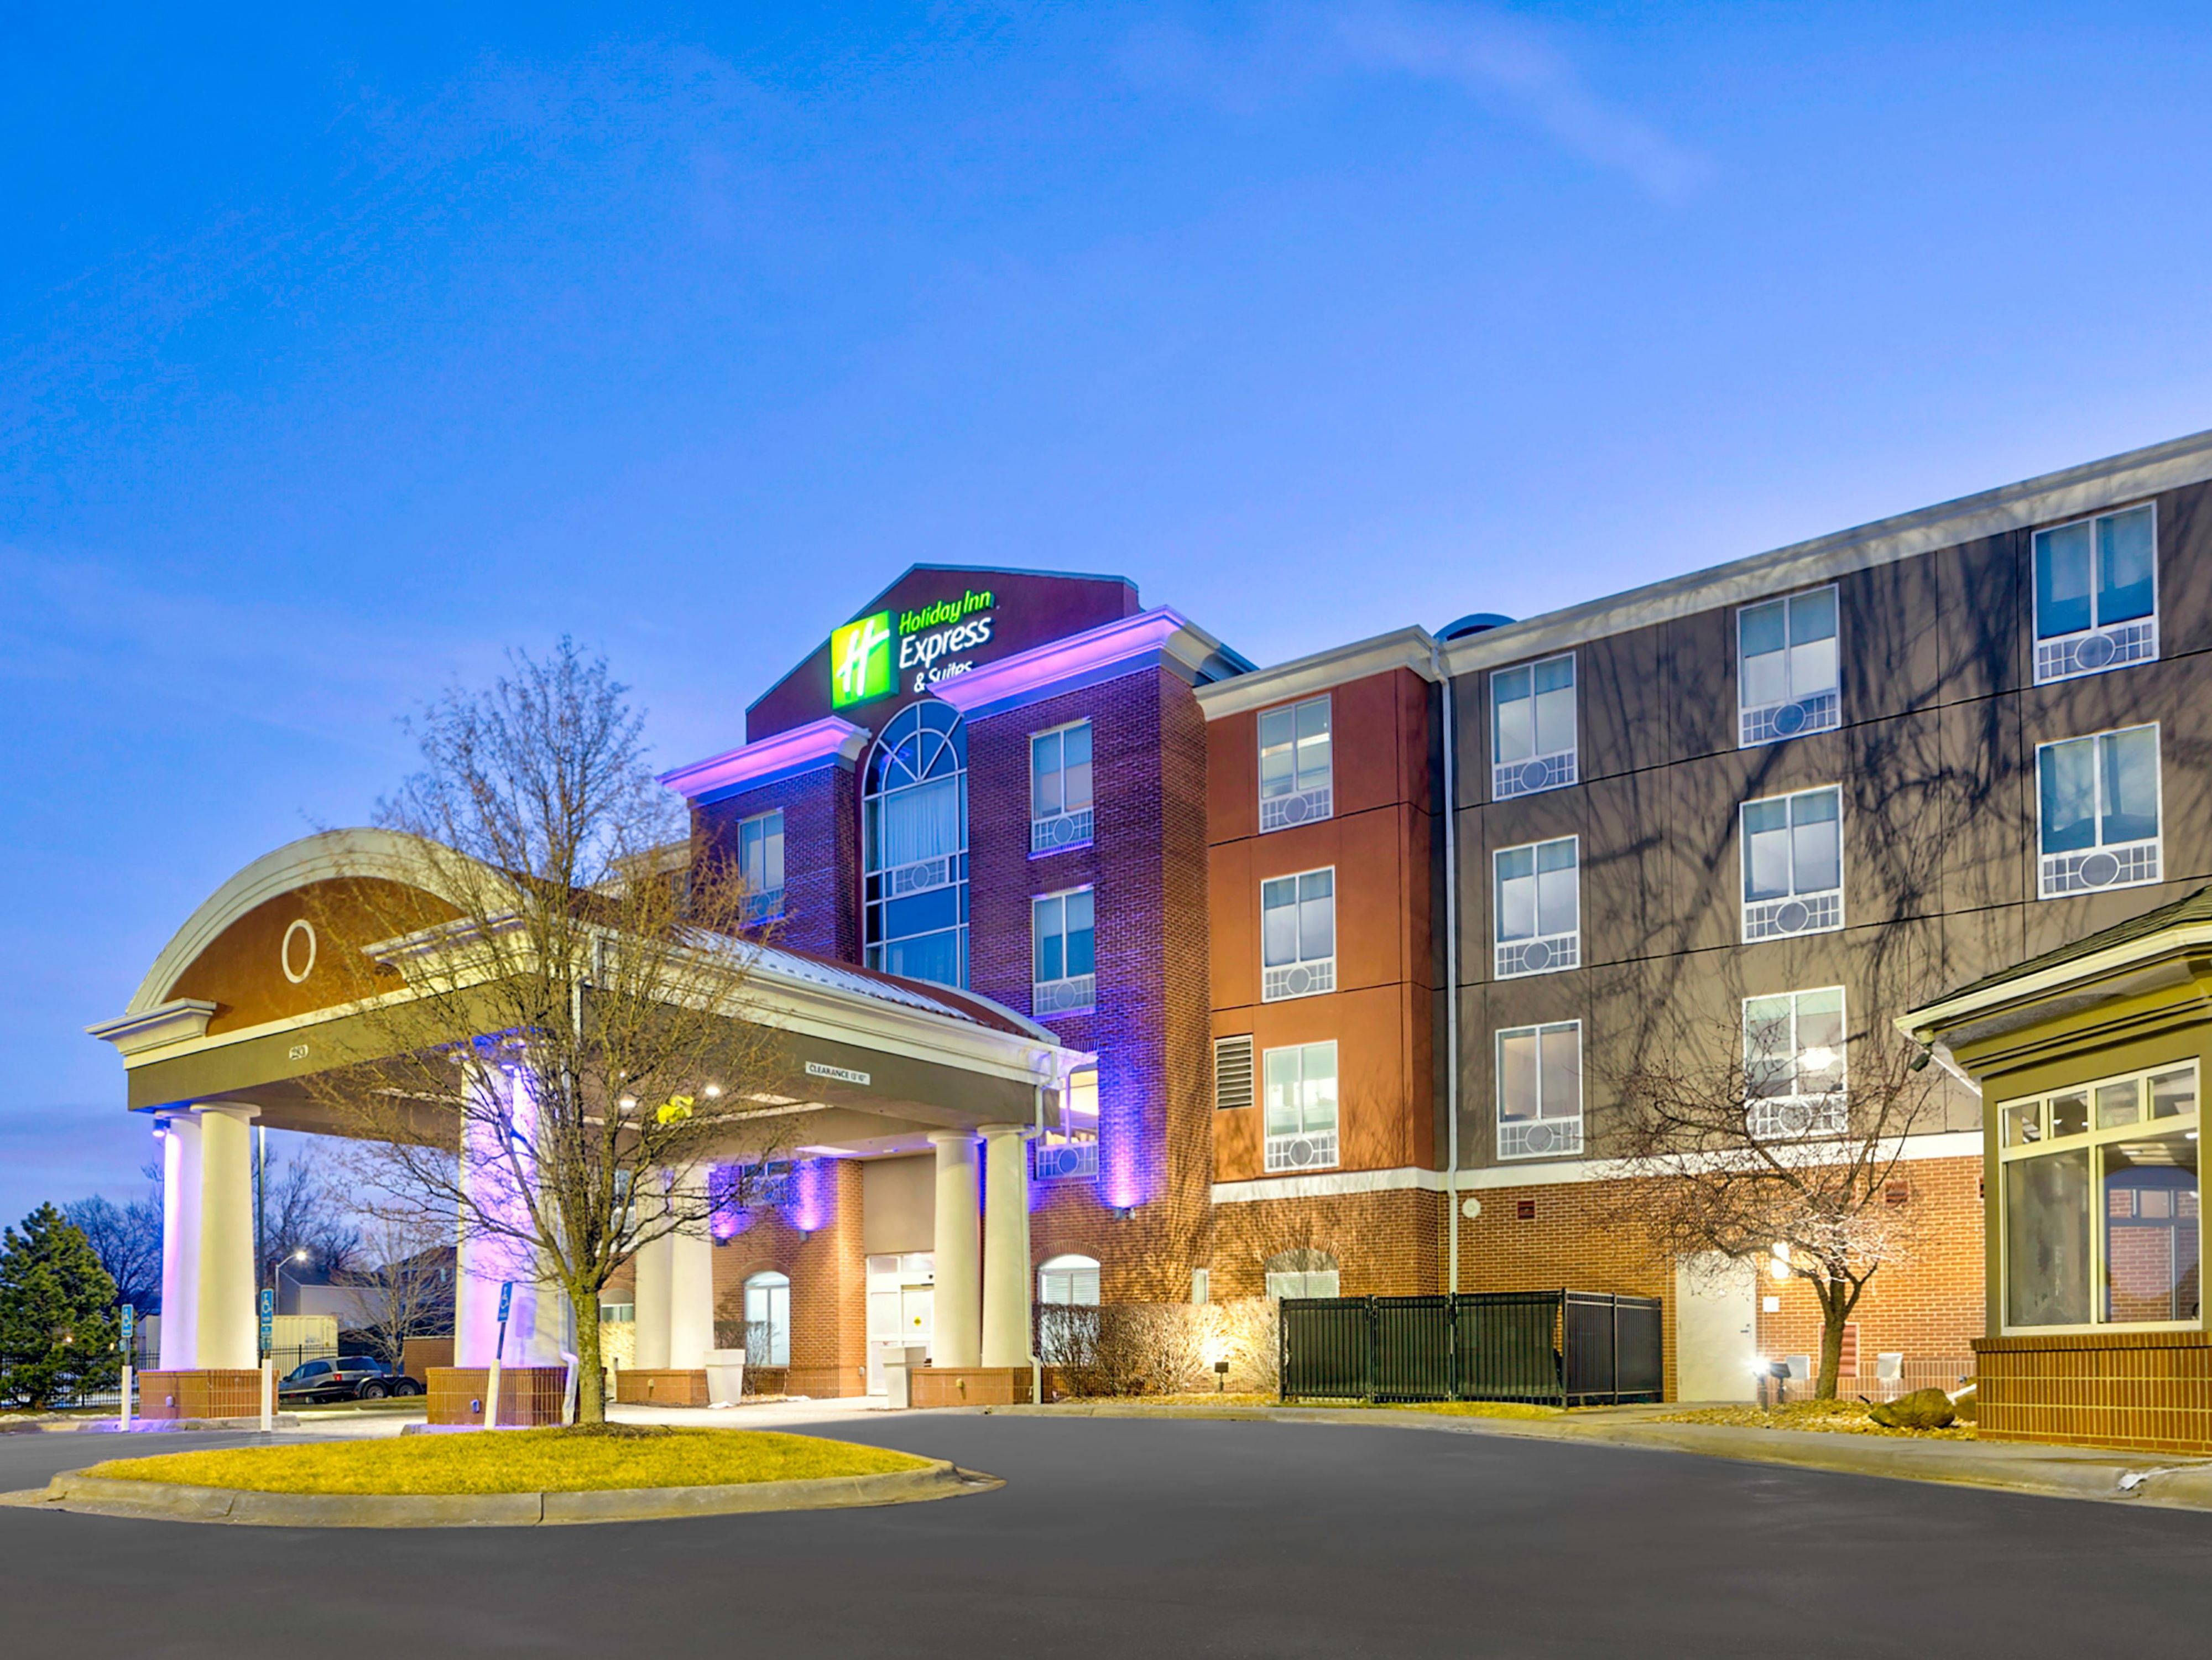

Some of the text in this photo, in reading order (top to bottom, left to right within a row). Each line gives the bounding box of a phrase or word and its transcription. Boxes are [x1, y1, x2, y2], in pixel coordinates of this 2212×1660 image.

[899, 590, 992, 636] Holiday Inn
[899, 617, 992, 669] Express
[914, 672, 926, 693] &
[808, 1064, 849, 1079] CLEARANCE
